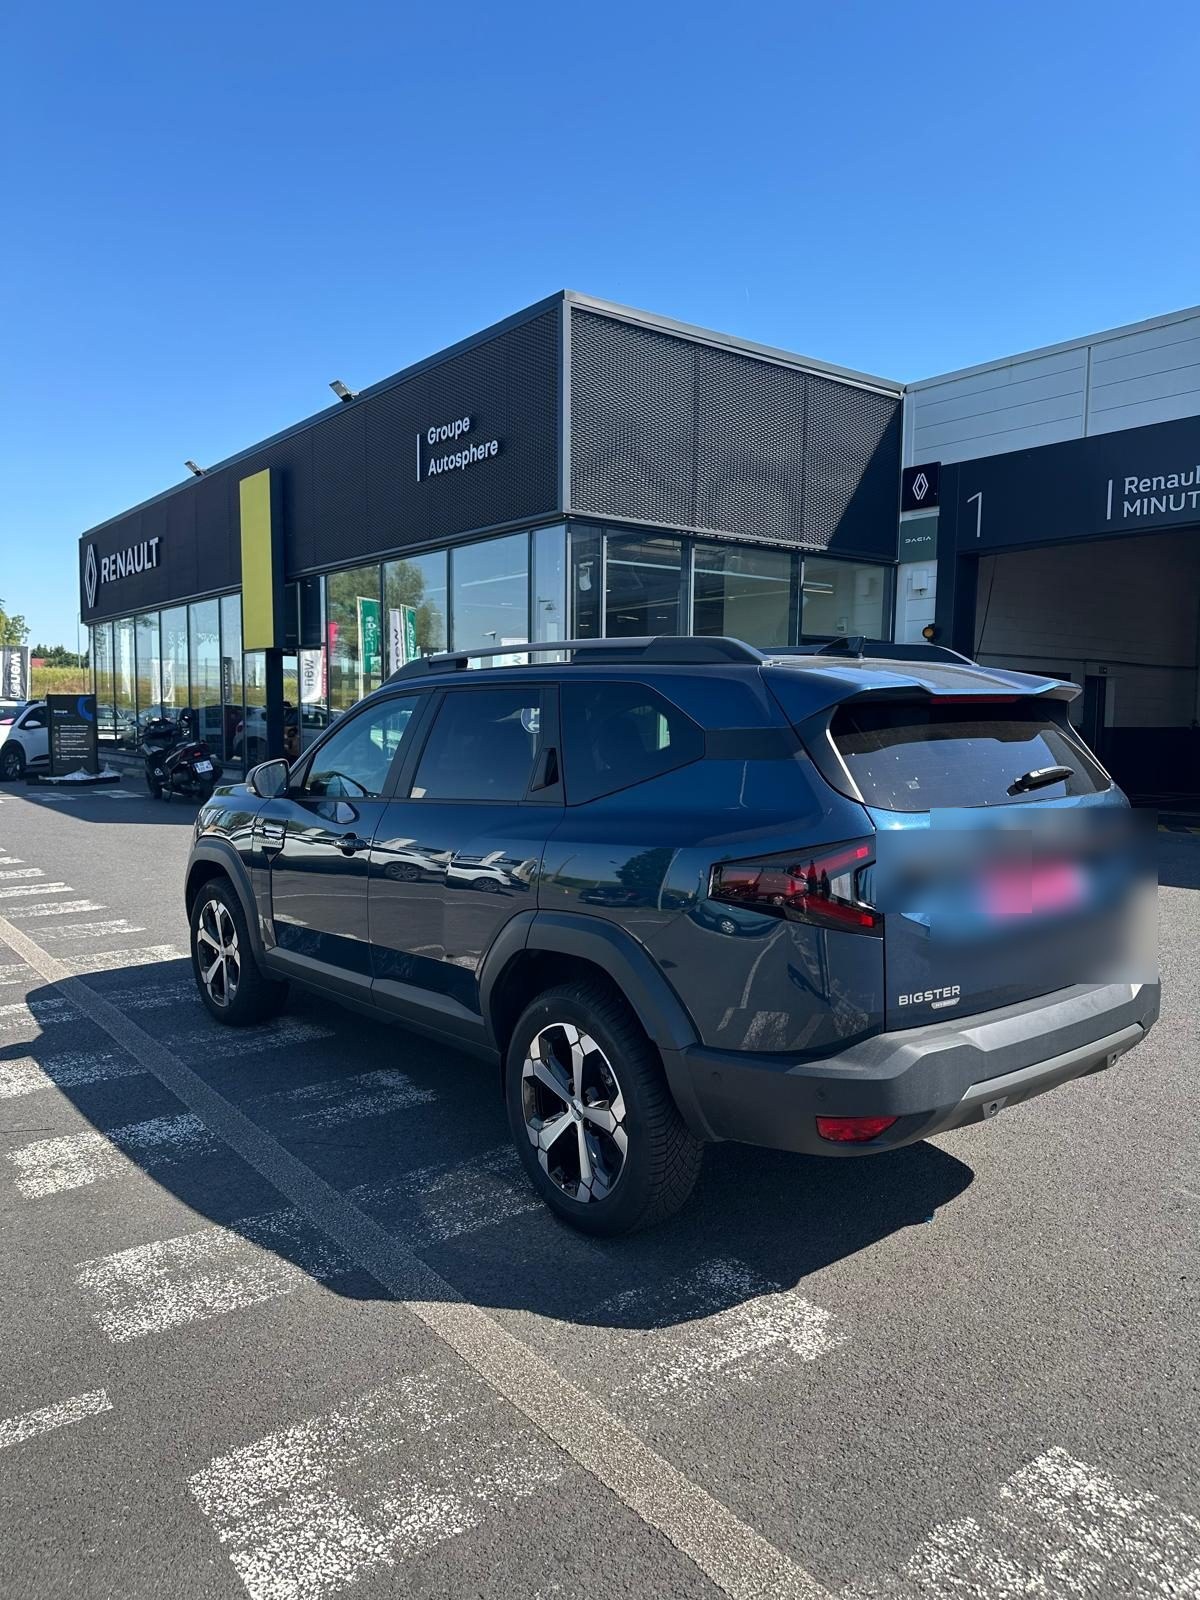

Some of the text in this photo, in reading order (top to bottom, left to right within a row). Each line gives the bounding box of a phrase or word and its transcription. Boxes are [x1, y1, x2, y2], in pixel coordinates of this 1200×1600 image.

[427, 417, 470, 445] Groupe
[428, 440, 499, 476] Autosphere
[966, 491, 982, 538] 1
[1123, 490, 1200, 518] MINUT
[904, 535, 932, 544] DACIA
[101, 536, 159, 584] RENAULT
[898, 985, 960, 1006] BIGSTER
